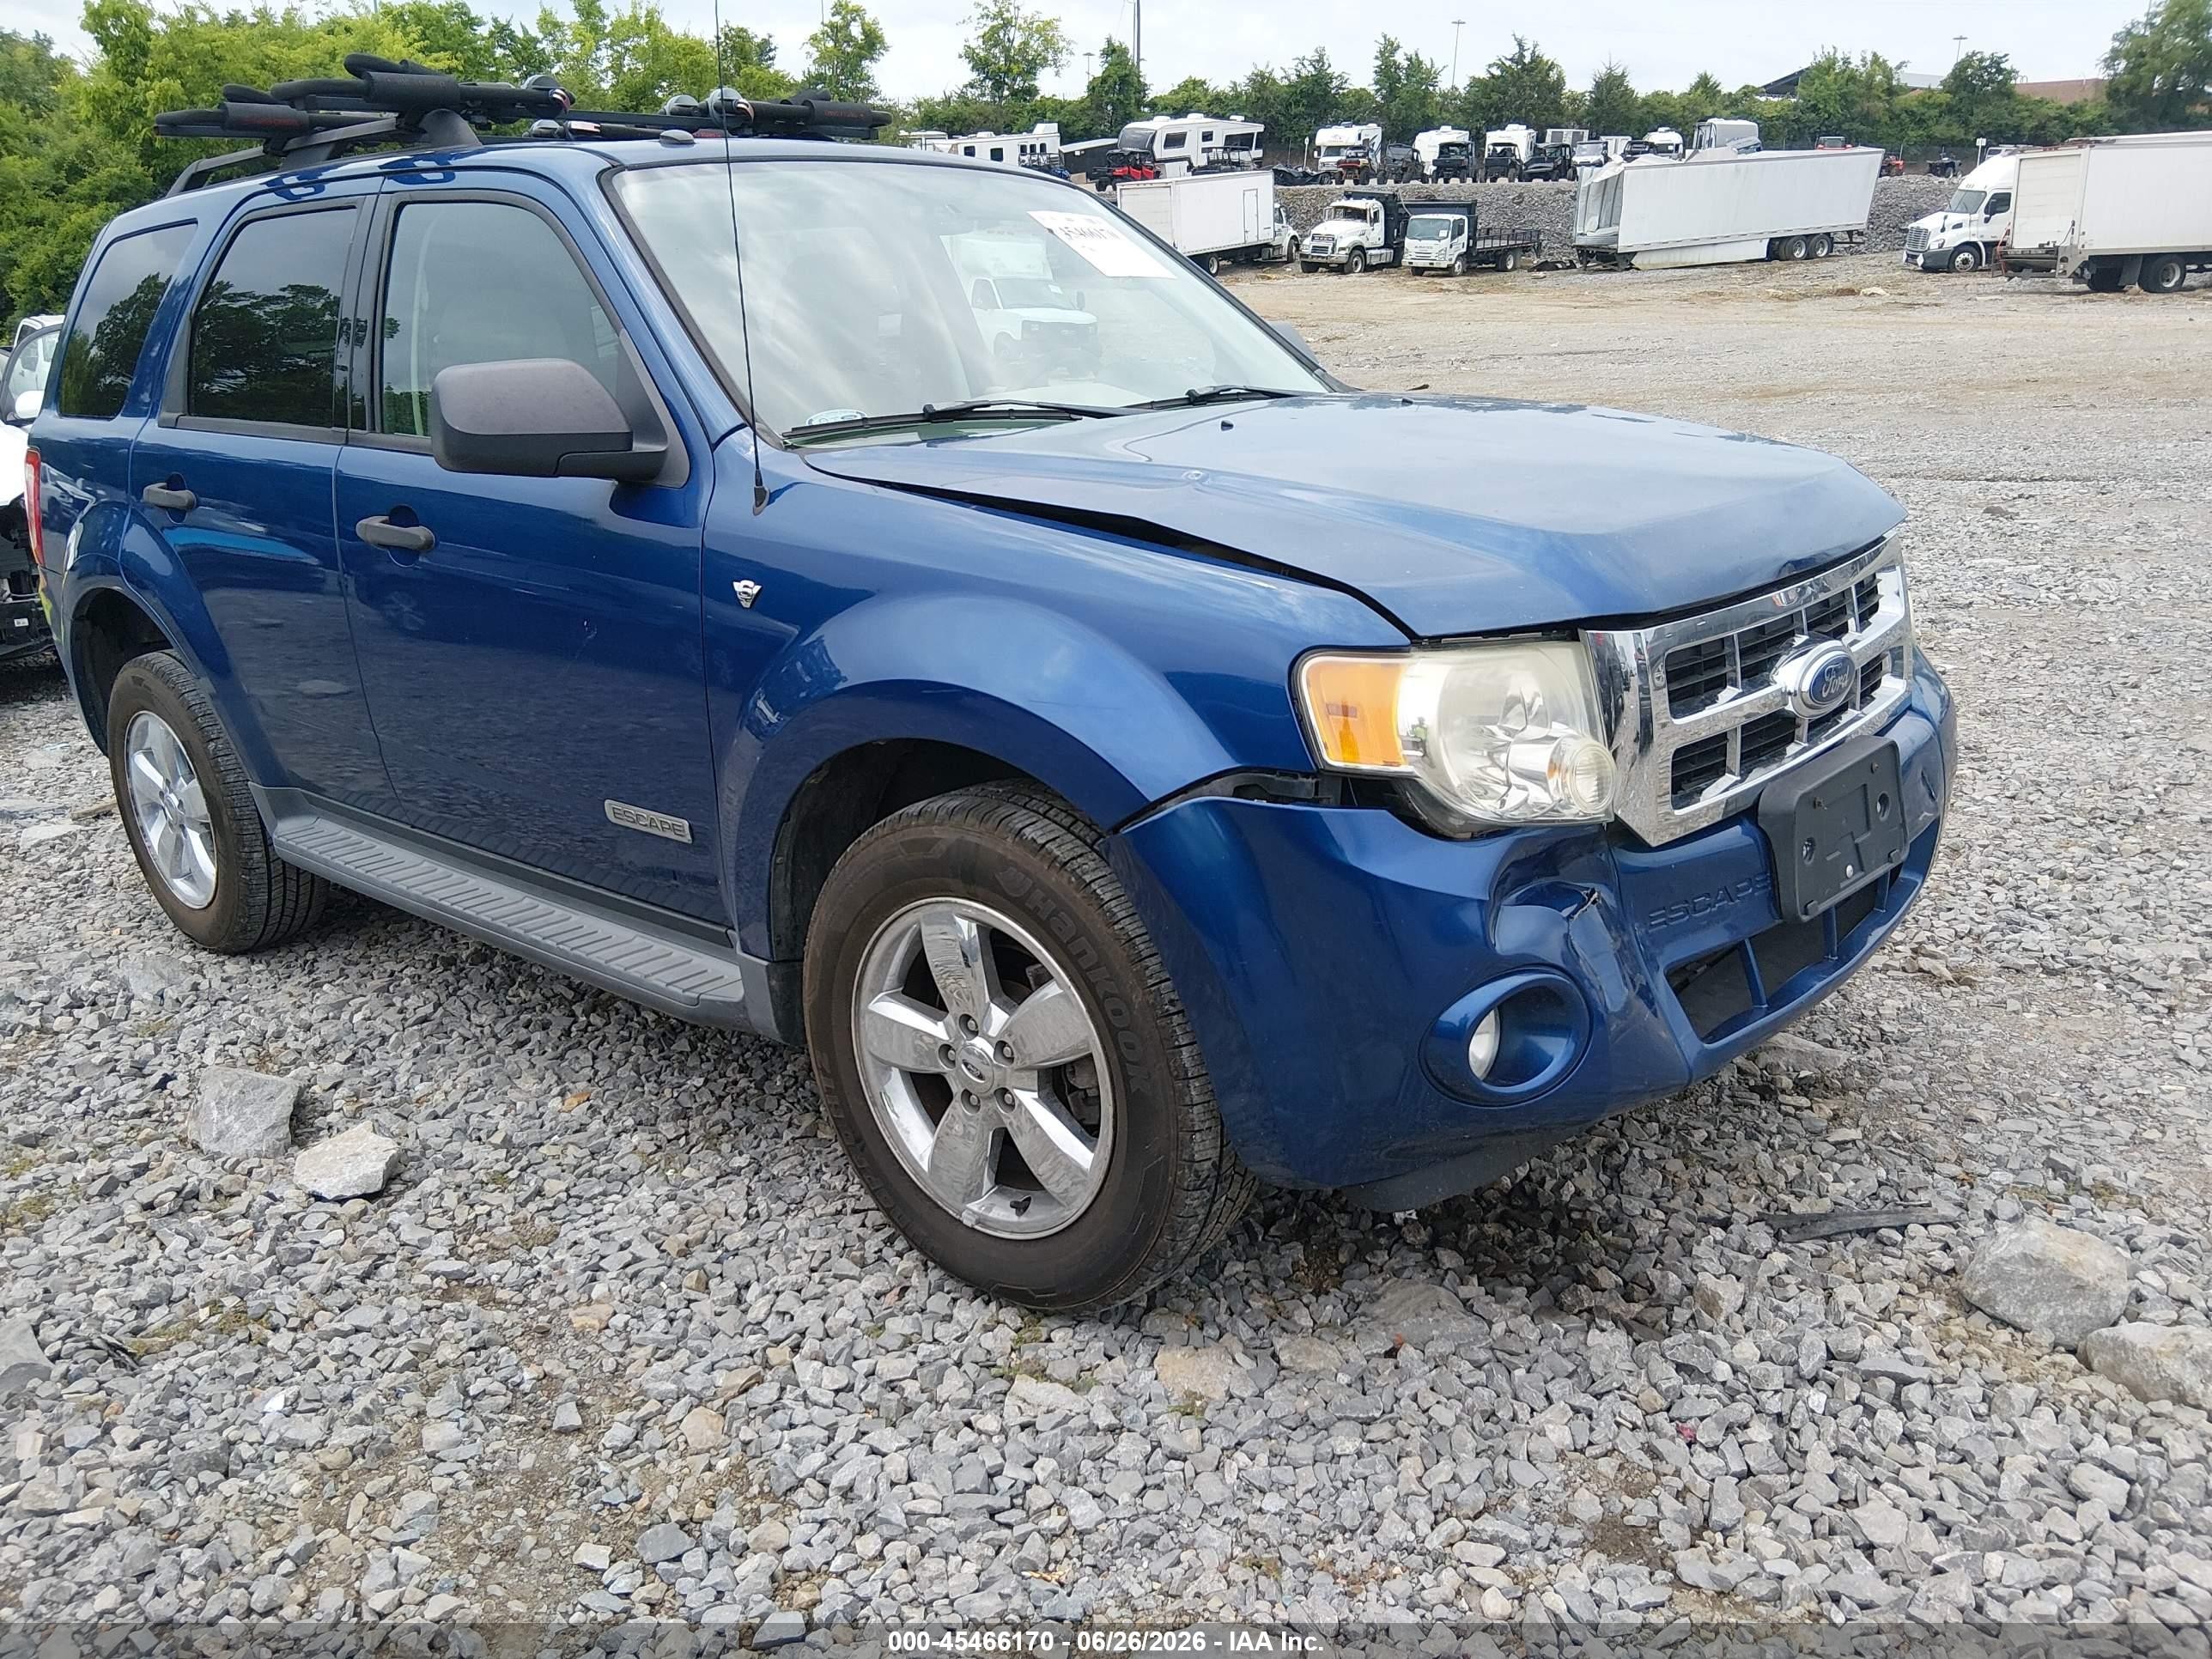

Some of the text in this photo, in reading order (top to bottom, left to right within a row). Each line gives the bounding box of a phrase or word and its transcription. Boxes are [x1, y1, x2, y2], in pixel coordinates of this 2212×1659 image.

[1821, 662, 1850, 698] Ford
[611, 805, 685, 837] ESCAPE
[1648, 871, 1770, 933] ESCAPE
